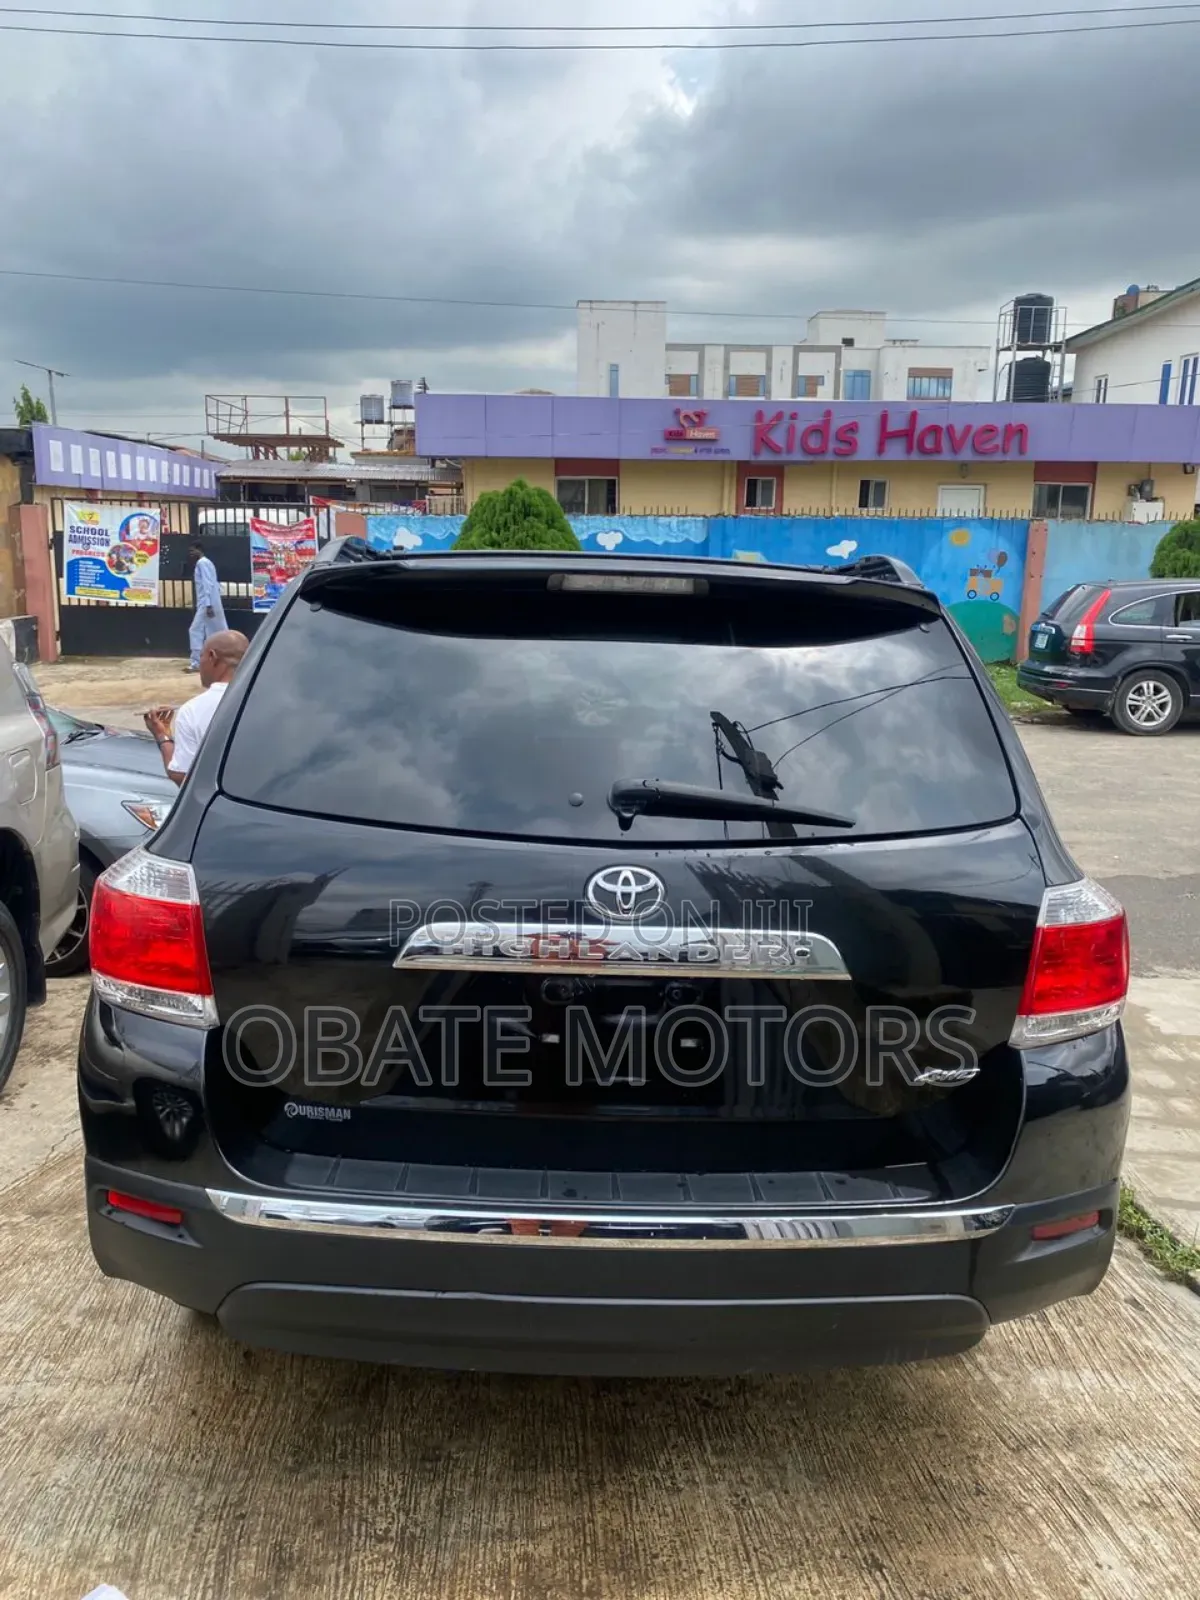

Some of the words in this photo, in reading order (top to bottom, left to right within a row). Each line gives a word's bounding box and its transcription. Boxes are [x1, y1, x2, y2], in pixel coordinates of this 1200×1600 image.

[753, 409, 859, 457] Kids
[876, 409, 1029, 457] Haven
[69, 525, 110, 537] SCHOOL
[68, 534, 111, 547] ADMISSION
[440, 936, 792, 965] HIGHLANDER
[284, 1102, 351, 1120] OURISMAN
